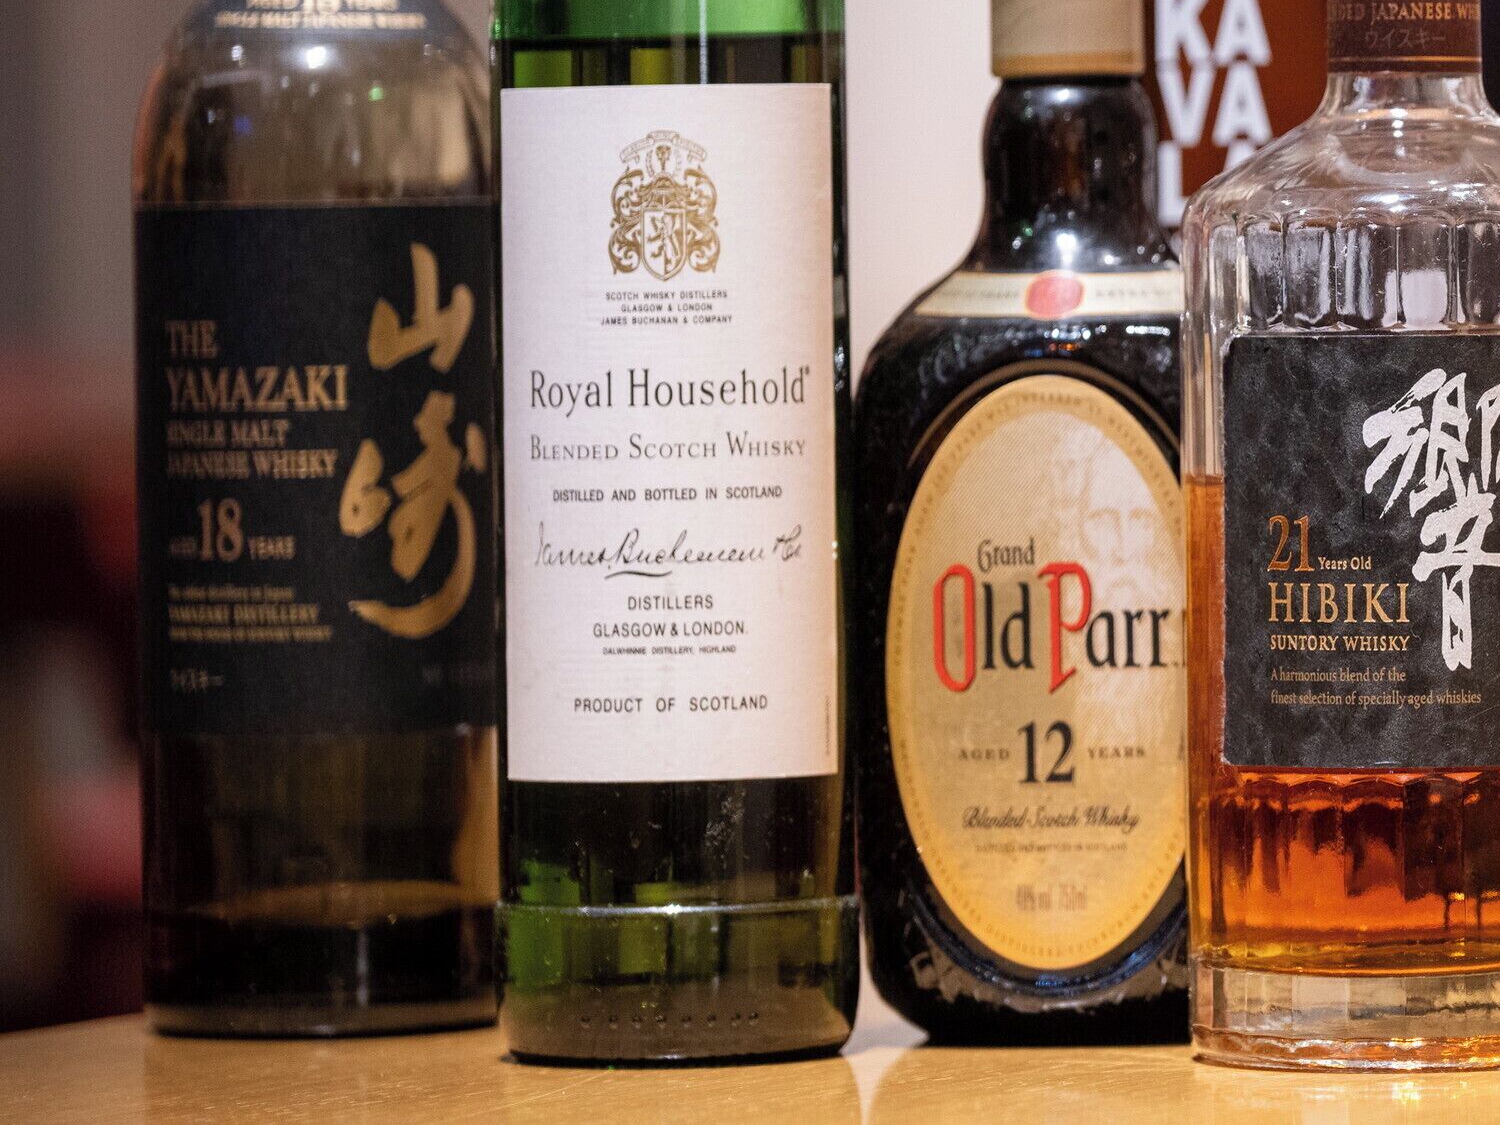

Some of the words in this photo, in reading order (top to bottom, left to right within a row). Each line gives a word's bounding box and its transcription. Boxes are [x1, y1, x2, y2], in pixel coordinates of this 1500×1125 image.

[1370, 2, 1450, 25] JAPANESE
[1365, 27, 1446, 49] ウイスキー
[1155, 61, 1273, 148] VA
[606, 291, 638, 300] SCOTCH
[643, 291, 675, 300] WHISKY
[680, 290, 727, 299] DISTILLERS
[621, 304, 662, 312] GLASGOW
[667, 304, 672, 312] &
[677, 303, 712, 311] LONDON
[601, 316, 627, 325] JAMES
[632, 316, 678, 324] BUCHANAN
[683, 316, 688, 324] &
[692, 315, 732, 324] COMPANY
[165, 320, 217, 357] THE
[166, 365, 348, 412] YAMAZAKI
[530, 369, 612, 418] Royal
[627, 366, 805, 408] Household
[338, 241, 488, 639] 山崎
[252, 449, 338, 478] WHISKY
[552, 489, 604, 502] DISTILLED
[611, 489, 636, 501] AND
[645, 488, 697, 501] BOTTLED
[705, 488, 717, 500] IN
[725, 486, 783, 499] SCOTLAND
[198, 498, 244, 563] 18
[1267, 515, 1315, 572] 21
[977, 539, 1035, 573] Grand
[1318, 556, 1347, 570] Years
[1350, 556, 1372, 570] Old
[628, 595, 713, 610] DISTILLERS
[1267, 582, 1410, 623] HIBIKI
[593, 622, 666, 638] GLASGOW
[671, 623, 678, 636] &
[932, 563, 1036, 692] Old
[1036, 562, 1176, 695] Parr
[602, 646, 646, 655] DALWHINNIE
[699, 645, 736, 654] HIGHLAND
[1270, 635, 1338, 652] SUNTORY
[1343, 635, 1410, 652] WHISKY
[1271, 668, 1279, 681] A
[1280, 668, 1337, 682] harmonious
[1340, 667, 1370, 681] blend
[1373, 667, 1386, 681] of
[1388, 668, 1406, 681] the
[574, 698, 642, 712] PRODUCT
[656, 698, 676, 712] OF
[689, 695, 768, 710] SCOTLAND
[1270, 690, 1297, 704] finest
[1299, 689, 1342, 704] selection
[1345, 690, 1357, 705] of
[1358, 690, 1405, 711] specially
[1407, 691, 1434, 710] aged
[1437, 690, 1482, 704] whiskies
[958, 748, 1010, 760] AGED
[1018, 721, 1075, 783] 12
[1088, 746, 1145, 759] YEARS
[962, 806, 1027, 828] Blended
[1032, 805, 1080, 826] Scotch
[1083, 805, 1141, 834] Whisky
